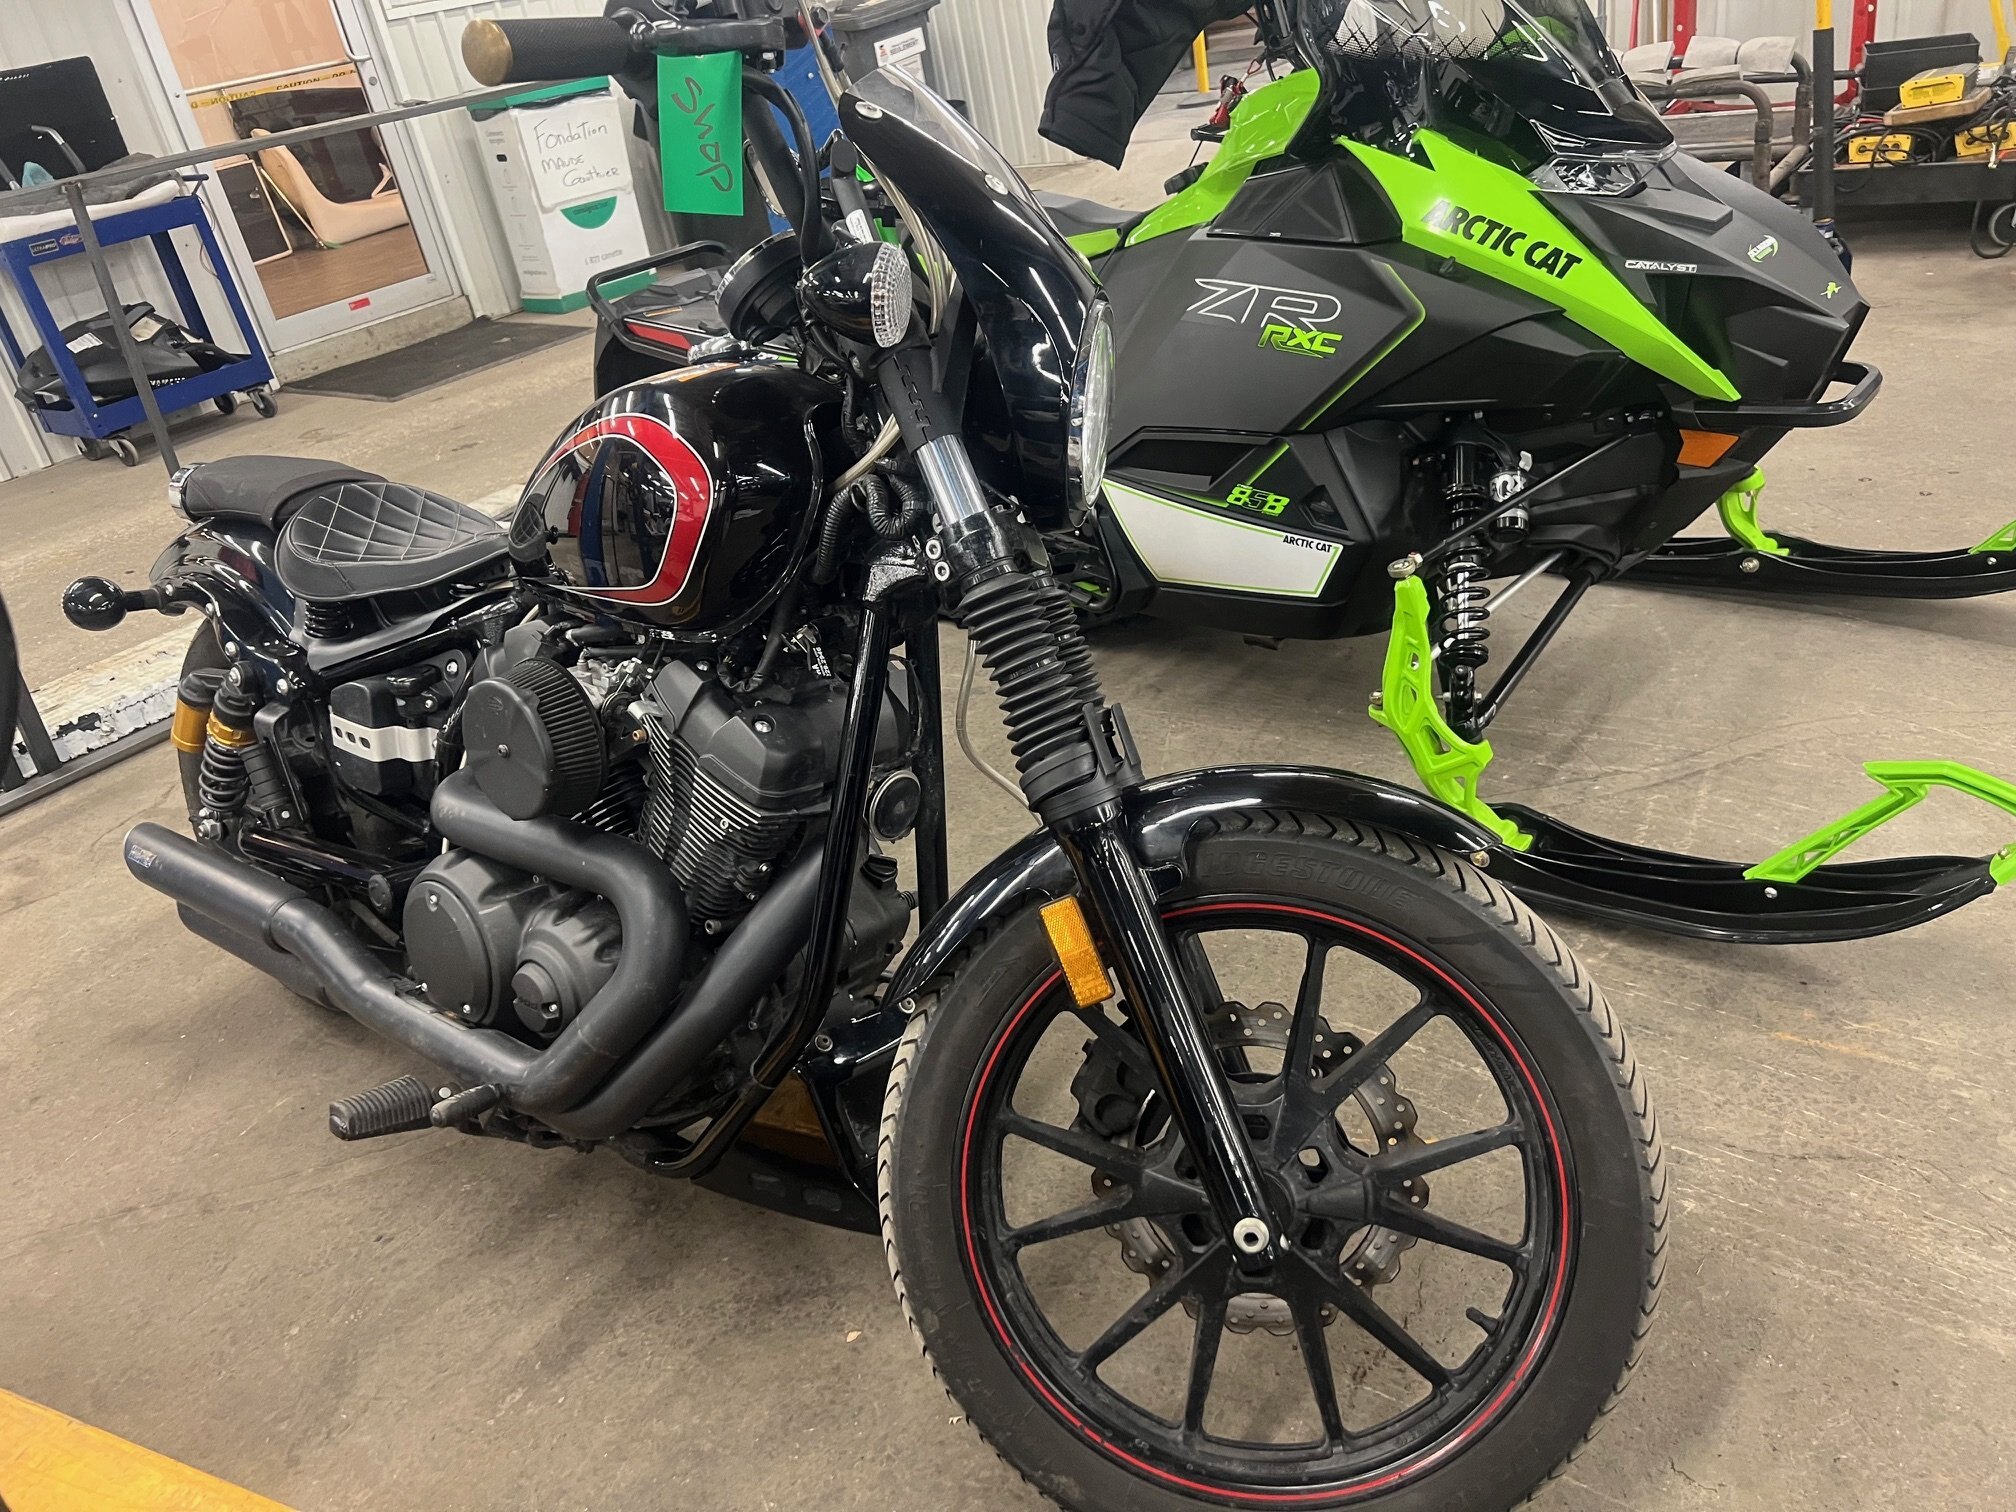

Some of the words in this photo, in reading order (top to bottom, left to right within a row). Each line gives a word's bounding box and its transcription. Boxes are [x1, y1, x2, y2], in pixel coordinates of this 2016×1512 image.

[276, 77, 320, 91] CAUTION
[1420, 200, 1527, 257] ARCTIC
[1523, 241, 1583, 280] CAT
[1624, 259, 1697, 273] CATALYST
[1257, 323, 1343, 359] RXC
[1226, 483, 1290, 517] 858
[1282, 535, 1315, 550] ARCTIC
[1315, 542, 1333, 554] CAT
